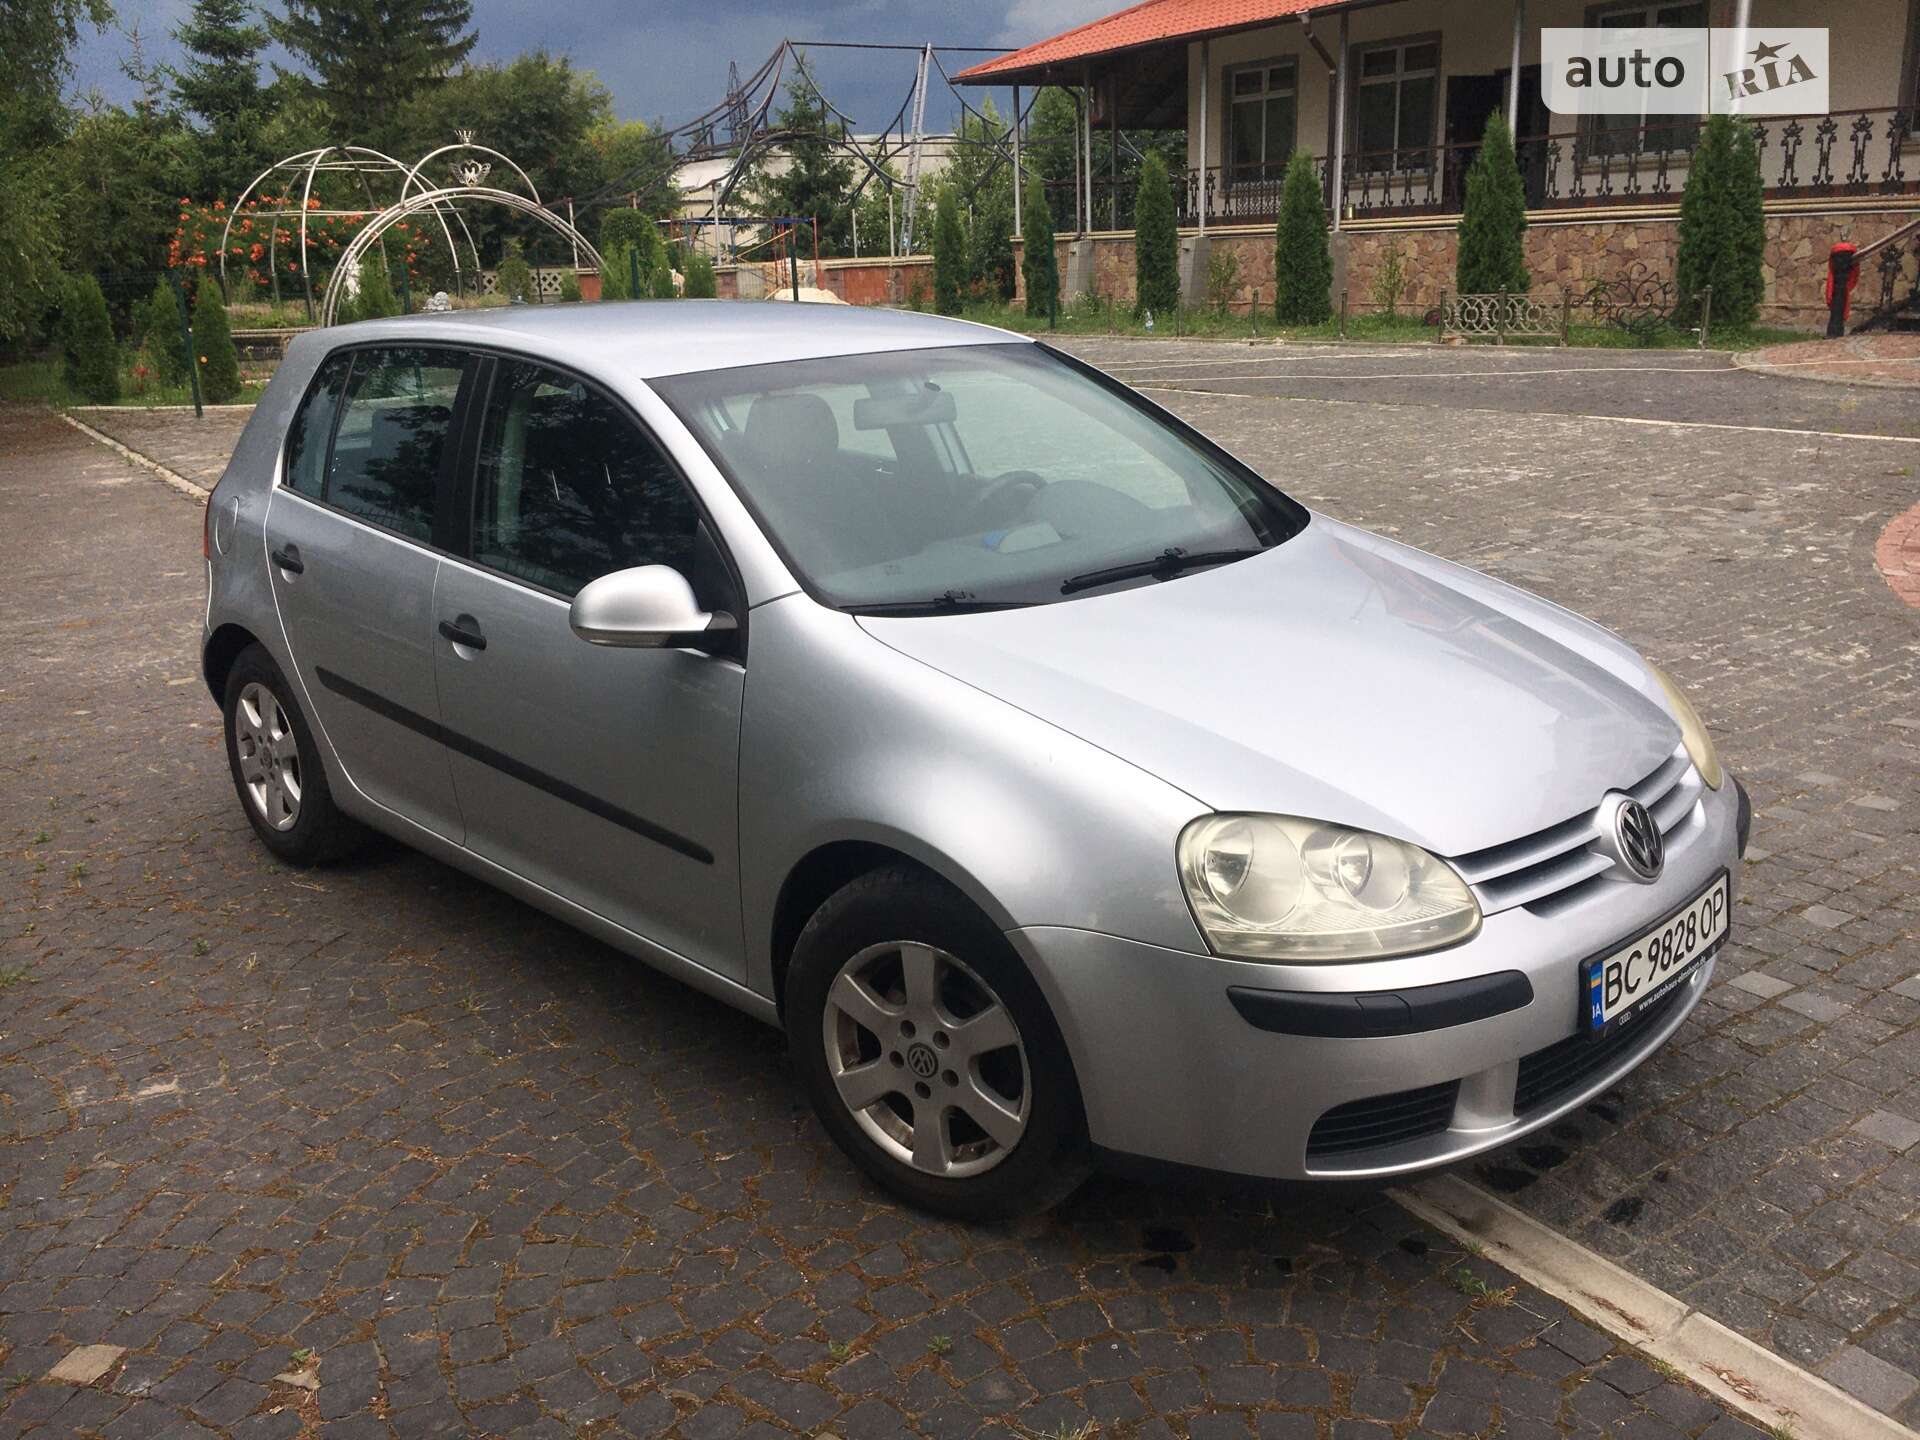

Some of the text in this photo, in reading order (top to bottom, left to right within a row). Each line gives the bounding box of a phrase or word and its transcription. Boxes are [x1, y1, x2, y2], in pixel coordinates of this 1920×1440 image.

[1604, 886, 1724, 1011] BC 9828 OP
